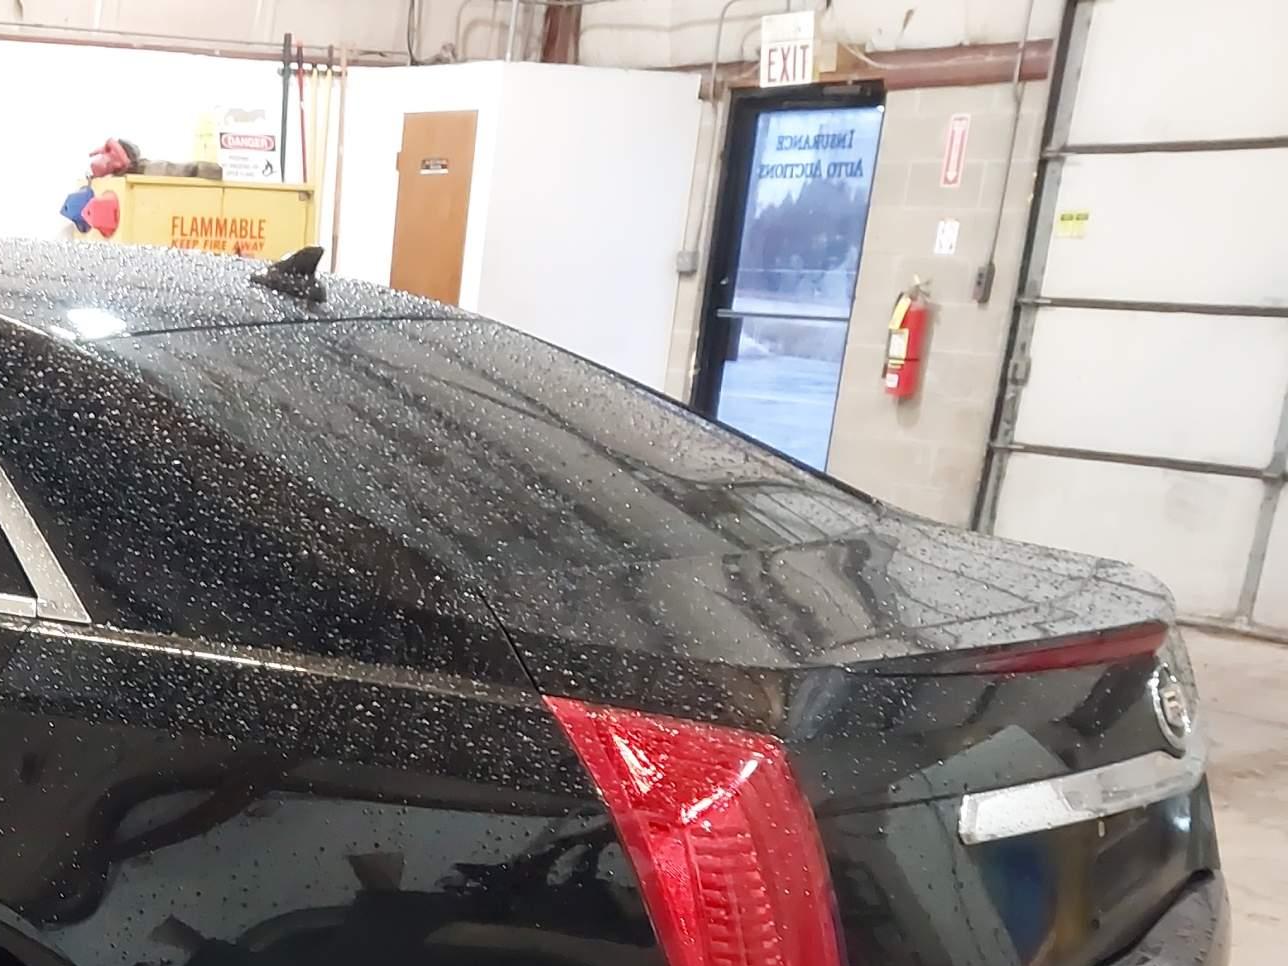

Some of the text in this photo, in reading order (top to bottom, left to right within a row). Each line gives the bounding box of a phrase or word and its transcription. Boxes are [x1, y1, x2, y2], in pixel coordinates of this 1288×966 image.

[767, 44, 809, 83] EXIT
[227, 135, 269, 149] DANGER
[171, 215, 267, 239] FLAMMABLE
[171, 239, 264, 251] KEEP FIRE AWAY
